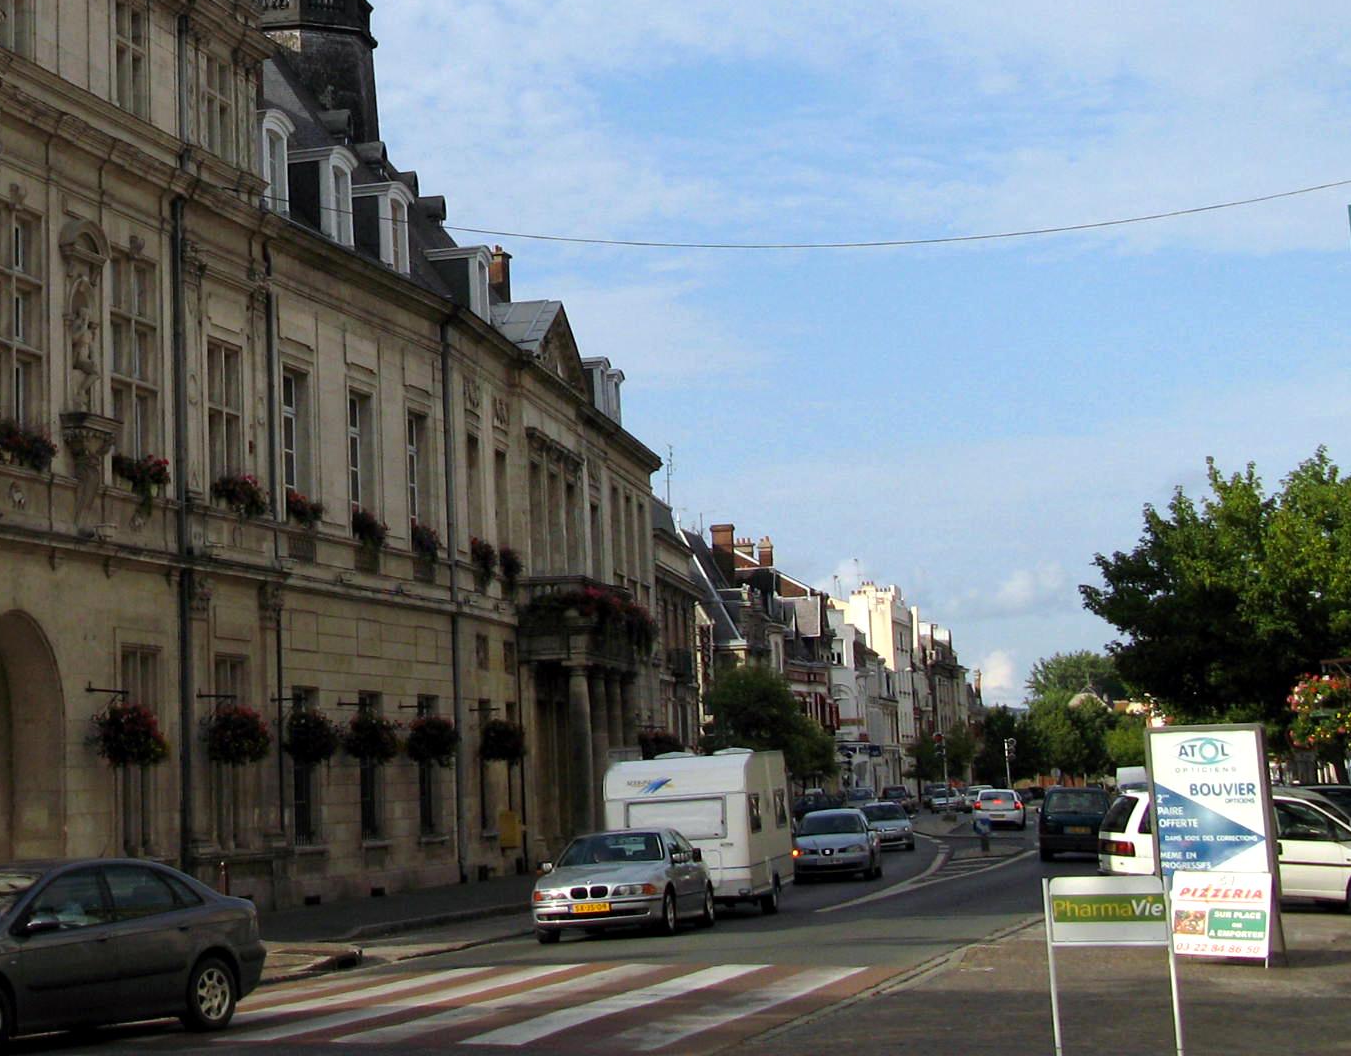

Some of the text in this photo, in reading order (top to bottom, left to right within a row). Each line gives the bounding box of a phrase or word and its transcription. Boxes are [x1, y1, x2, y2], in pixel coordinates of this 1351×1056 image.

[1178, 740, 1229, 762] ATOL
[1189, 783, 1257, 796] BOUVIER
[1157, 806, 1184, 815] PAIRE
[1159, 818, 1198, 828] OFFERTE
[1186, 851, 1197, 859] EN
[1179, 886, 1264, 899] PIZZERIA
[1053, 895, 1164, 918] PharmaVie
[1214, 910, 1261, 919] SUR PLACE
